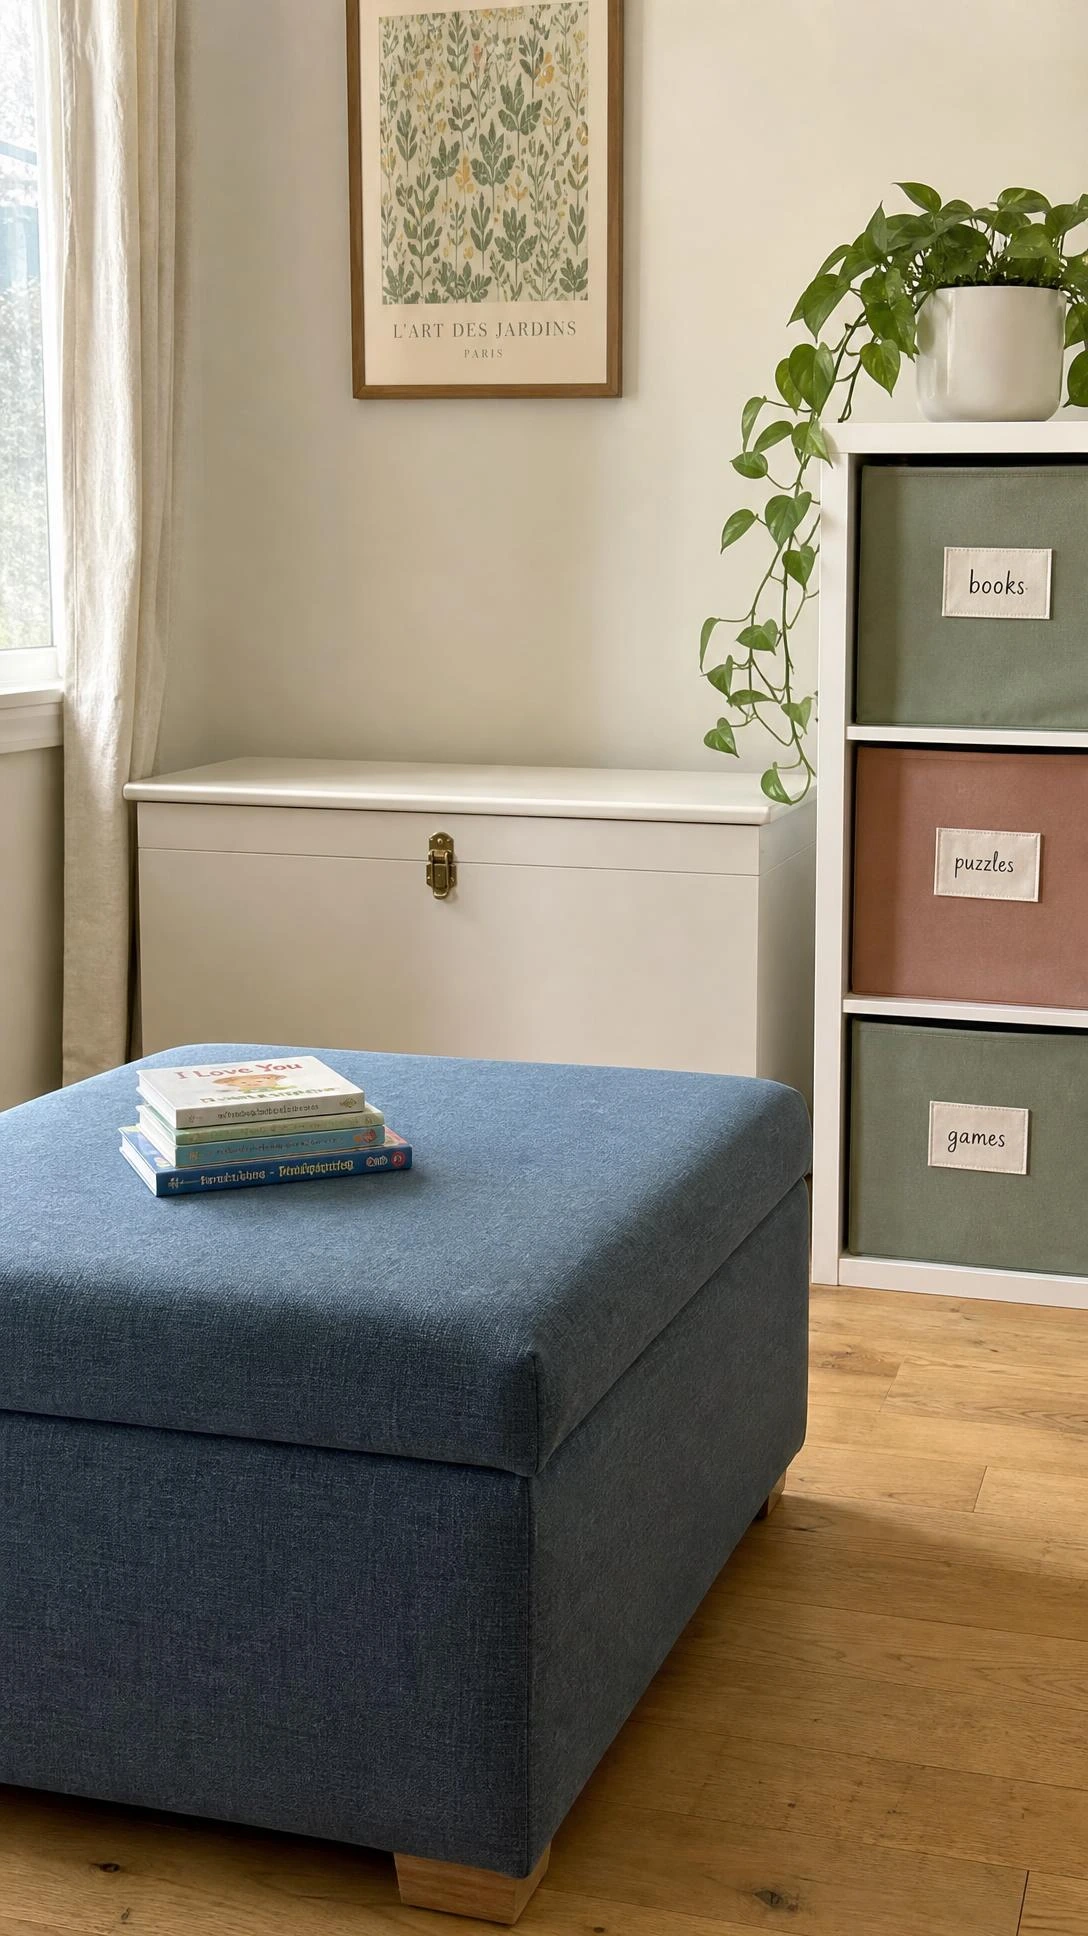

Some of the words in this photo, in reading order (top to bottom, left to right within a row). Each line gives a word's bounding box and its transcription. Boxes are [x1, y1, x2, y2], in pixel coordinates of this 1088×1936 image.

[393, 323, 444, 339] L'ART
[452, 322, 488, 338] DES
[496, 320, 577, 339] JARDINS
[464, 348, 504, 359] PARIS
[969, 568, 1025, 595] books
[954, 850, 1015, 879] puzzles
[175, 1070, 188, 1080] I
[947, 1130, 1006, 1153] games
